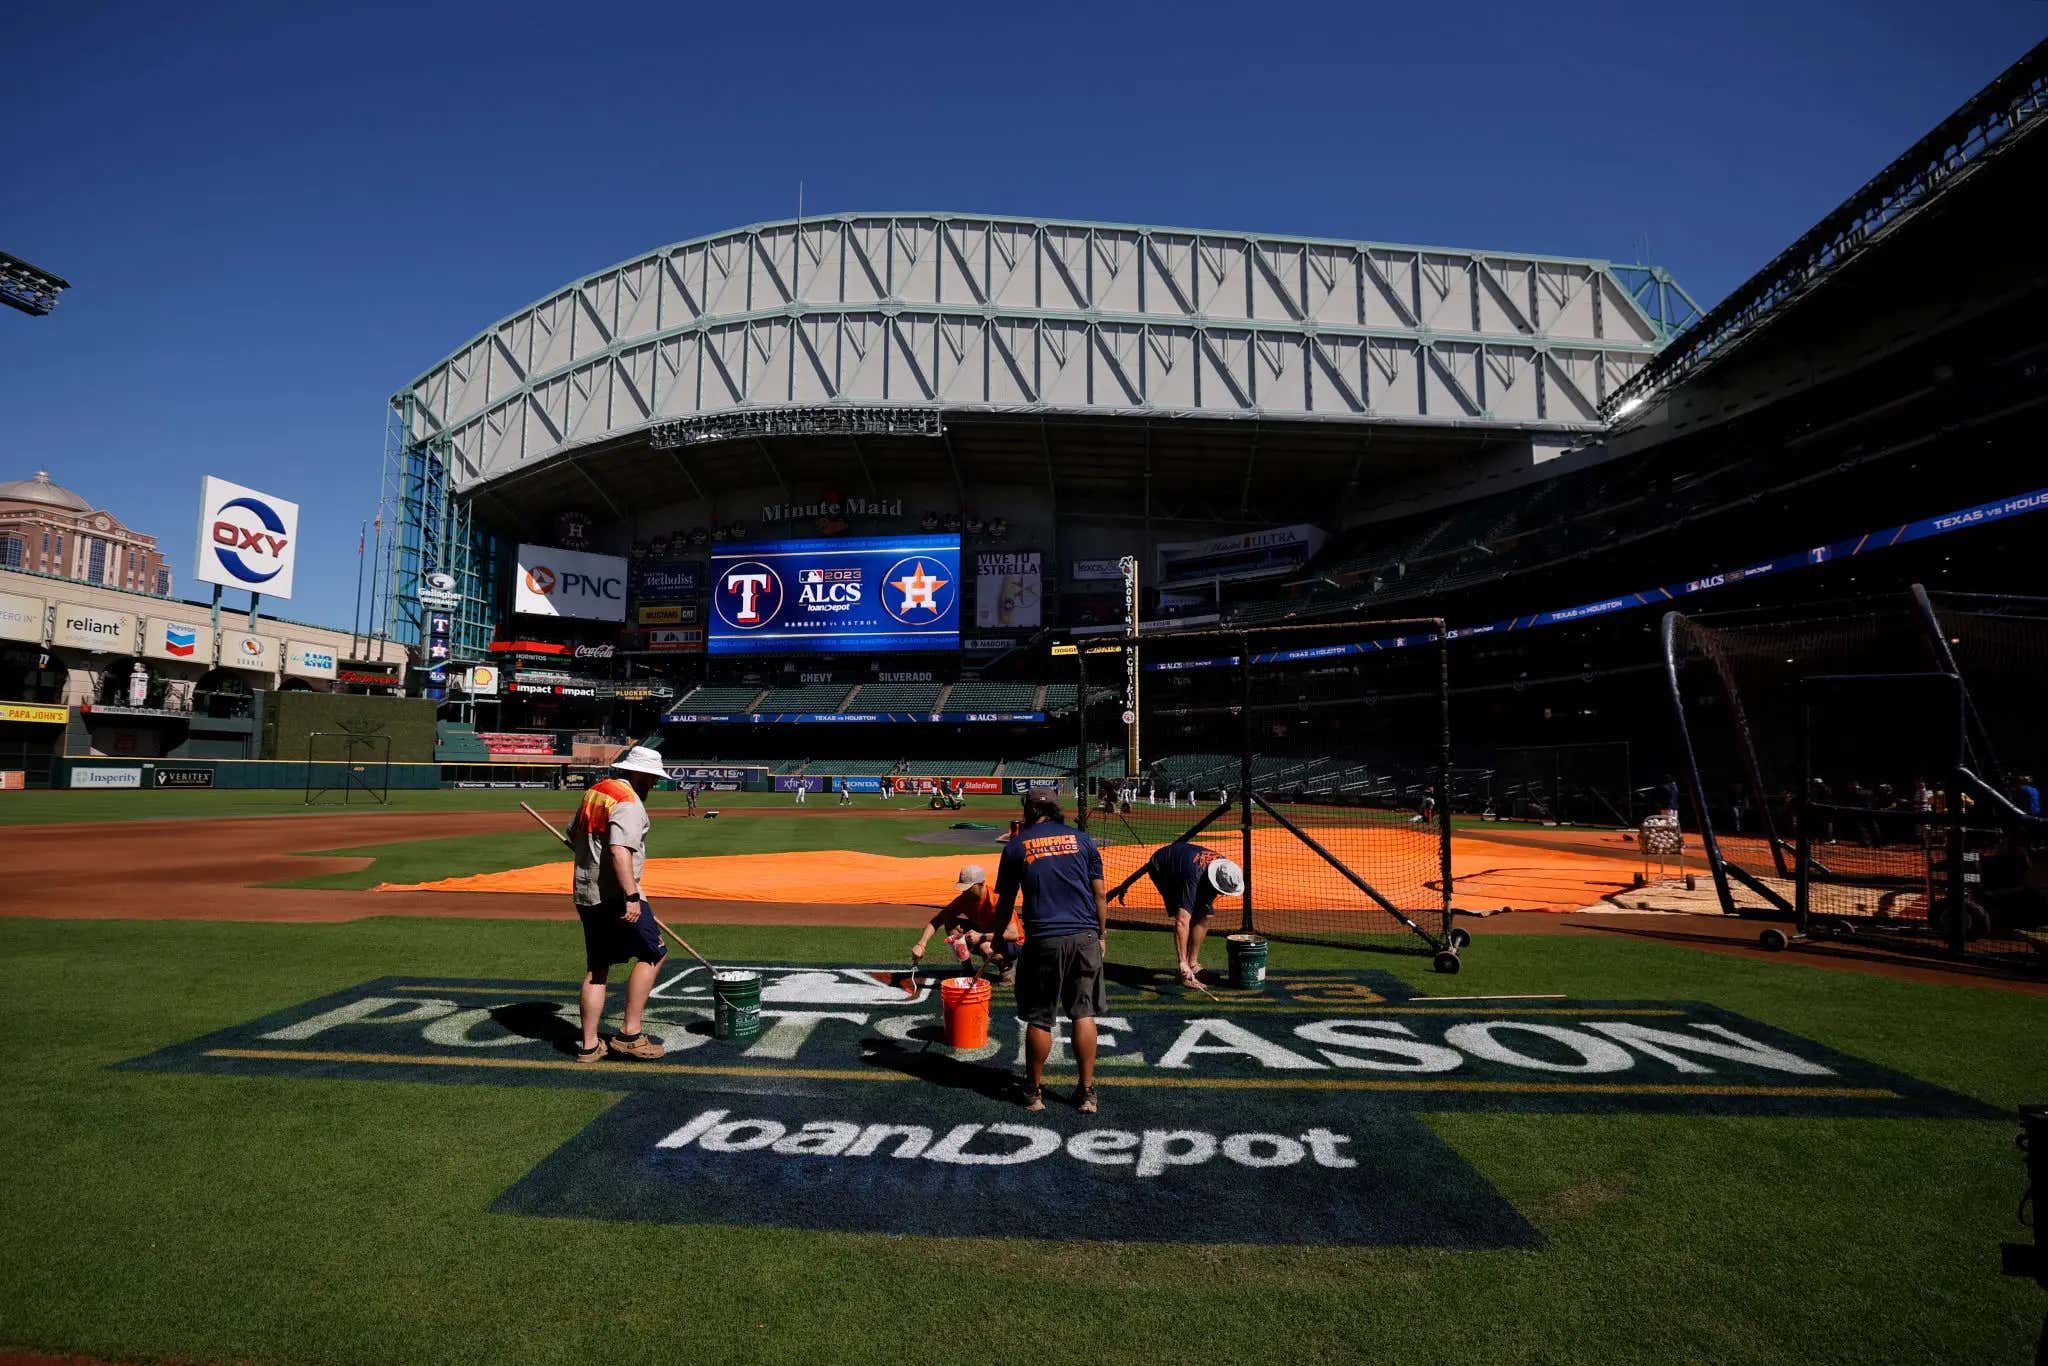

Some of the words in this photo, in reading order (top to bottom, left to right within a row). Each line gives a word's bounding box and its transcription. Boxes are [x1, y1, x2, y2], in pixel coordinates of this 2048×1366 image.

[763, 499, 841, 521] Minute
[846, 497, 902, 517] Maid
[1934, 510, 1983, 529] TEXAS
[1986, 507, 2002, 517] vs
[213, 521, 288, 558] OXY
[979, 553, 1010, 564] VIVE
[1013, 552, 1029, 563] TU
[976, 563, 1038, 575] ESTRELLA
[824, 571, 862, 580] 2023
[560, 572, 621, 600] PNC
[1700, 574, 1725, 590] ALCS
[418, 587, 462, 600] Gallagher
[798, 583, 863, 603] ALCS
[807, 603, 850, 612] loanDepot
[1552, 609, 1578, 621] TEXAS
[1586, 600, 1623, 614] HOUSTON
[66, 617, 120, 636] reliant
[167, 623, 197, 633] Chevron
[800, 672, 833, 682] CHEVY
[879, 671, 933, 681] SILVERADO
[517, 685, 552, 694] impact
[562, 688, 595, 697] impact
[8, 709, 31, 719] PAPA
[33, 710, 64, 721] JOHN'S
[680, 714, 697, 723] ALCS
[90, 772, 138, 785] Insperity
[170, 772, 210, 780] VERITEX
[1022, 835, 1077, 849] TURFACE
[1026, 844, 1079, 855] ATHLETICS
[656, 1108, 1357, 1178] loanDepot
